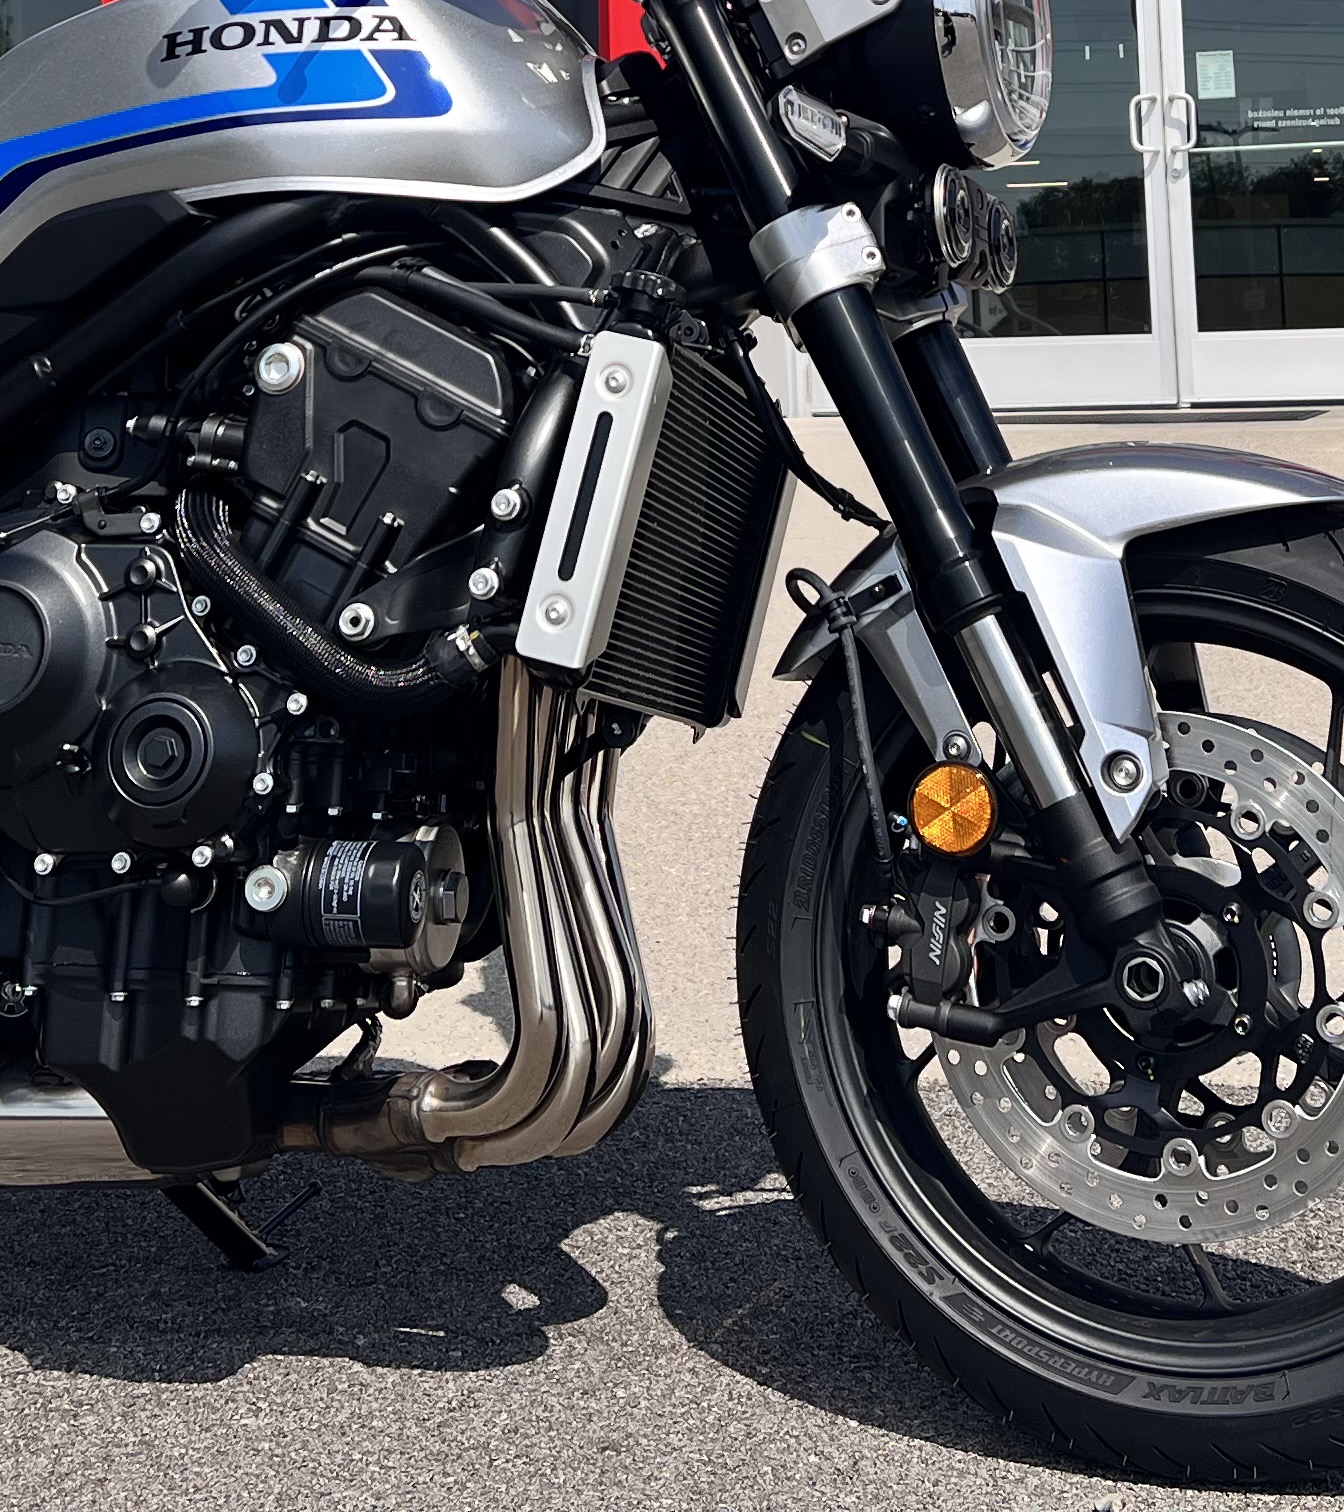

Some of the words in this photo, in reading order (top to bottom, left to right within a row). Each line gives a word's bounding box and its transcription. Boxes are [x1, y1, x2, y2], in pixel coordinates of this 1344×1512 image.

[160, 14, 417, 63] HONDA
[986, 1322, 1117, 1388] HYPERSPORT
[1139, 1380, 1277, 1407] BATTLAX
